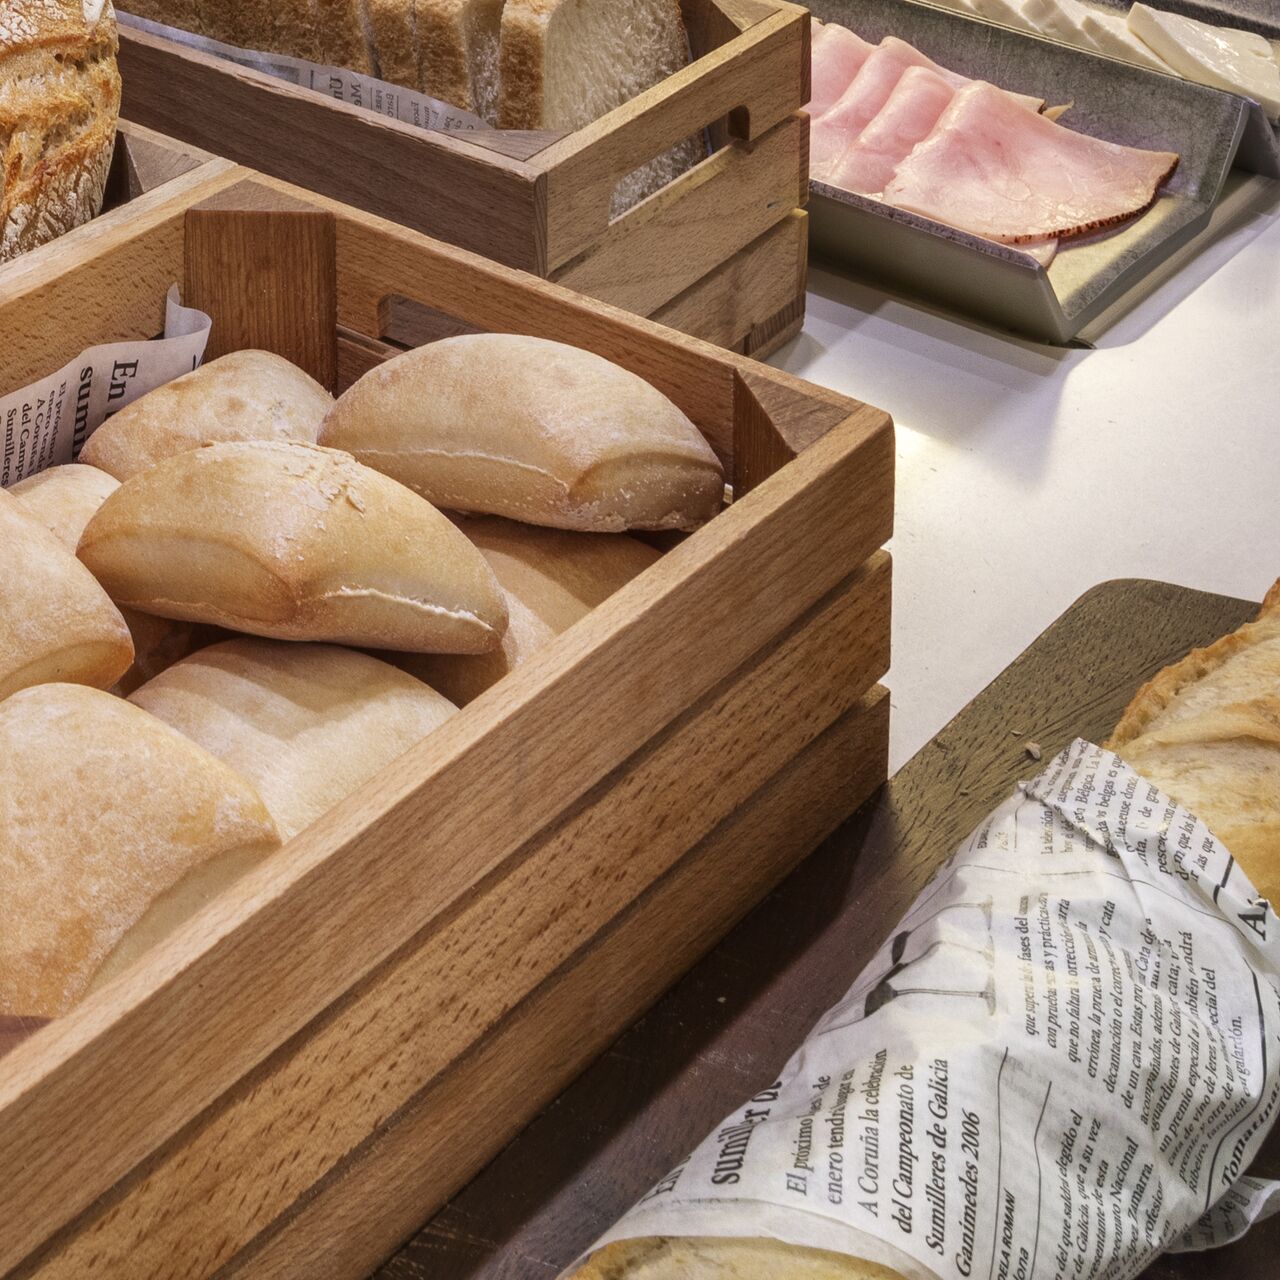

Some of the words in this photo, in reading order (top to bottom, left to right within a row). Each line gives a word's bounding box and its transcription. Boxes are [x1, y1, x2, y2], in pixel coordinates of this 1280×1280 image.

[107, 359, 139, 402] En
[21, 403, 32, 426] del
[1095, 780, 1117, 808] belgas
[1014, 917, 1029, 934] del
[1101, 900, 1115, 927] cata
[894, 1065, 914, 1081] de
[1102, 1018, 1122, 1094] decantación
[928, 1059, 948, 1120] Galicia
[1128, 1070, 1139, 1090] un
[858, 1109, 879, 1123] la
[1168, 1087, 1193, 1138] premio
[892, 1084, 919, 1199] Campeonato
[926, 1123, 947, 1149] de
[961, 1108, 980, 1161] 2006
[1056, 1127, 1077, 1177] elegido
[1070, 1108, 1083, 1126] el
[828, 1152, 843, 1205] enero
[857, 1126, 879, 1194] Coruña
[1096, 1160, 1109, 1188] esta
[1109, 1136, 1139, 1203] Nacional
[786, 1173, 807, 1196] El
[925, 1152, 946, 1255] Sumilleres
[857, 1201, 878, 1218] A
[891, 1199, 912, 1234] del
[955, 1161, 978, 1277] Ganimedes
